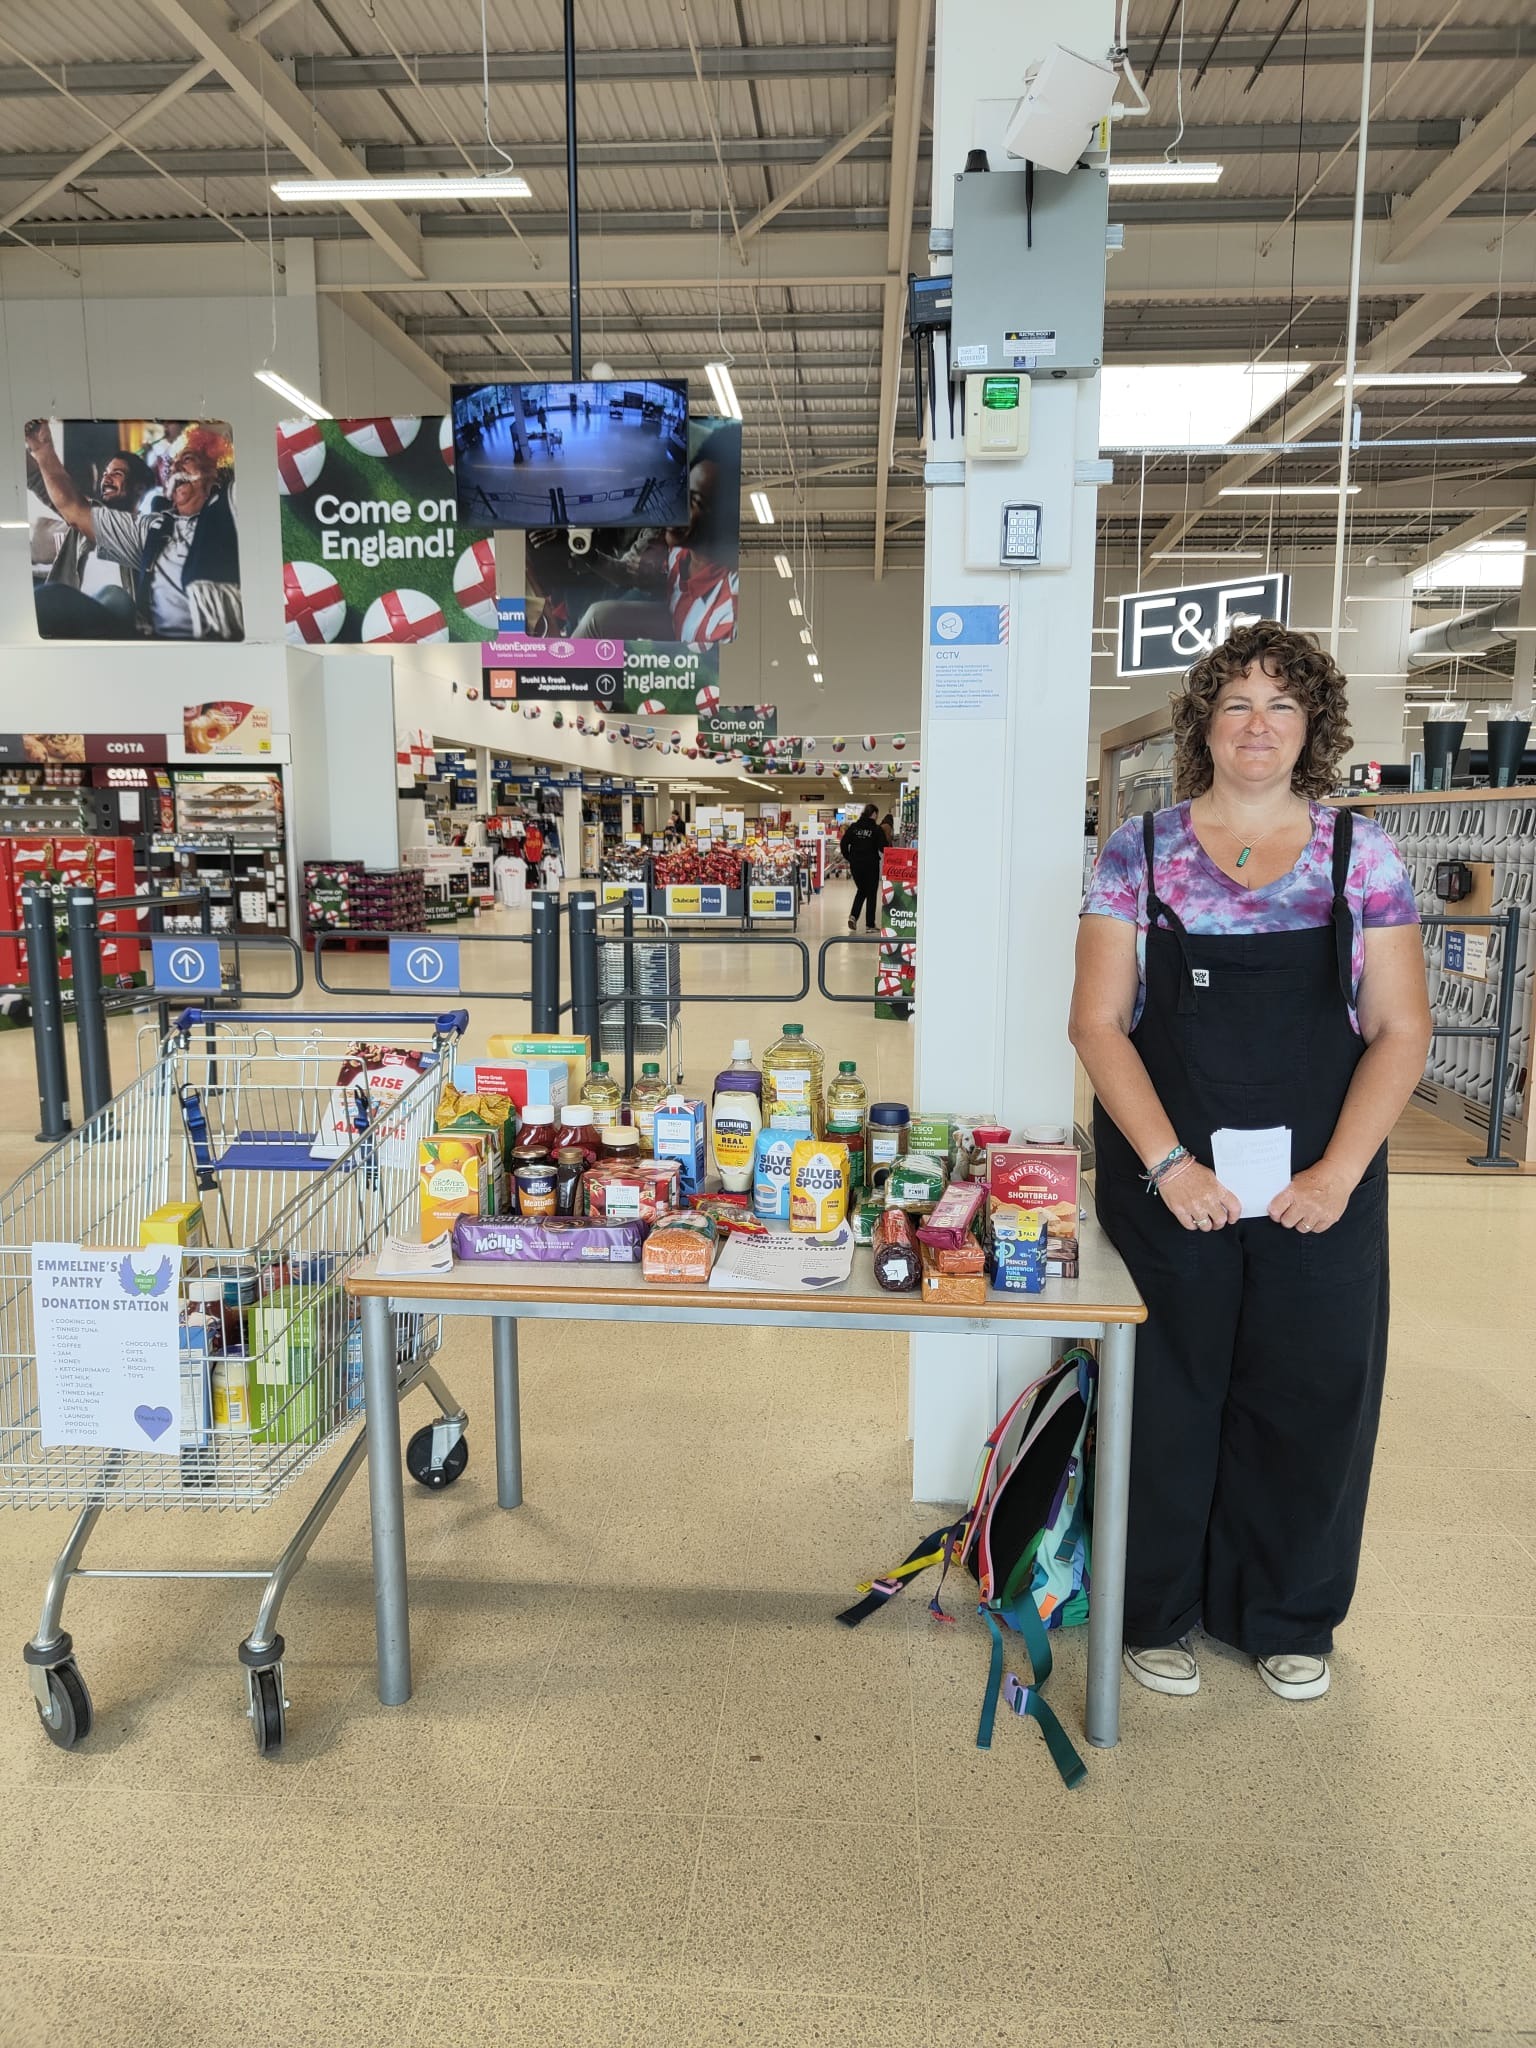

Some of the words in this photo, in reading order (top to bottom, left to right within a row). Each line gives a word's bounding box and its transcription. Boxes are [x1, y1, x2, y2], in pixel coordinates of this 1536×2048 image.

[315, 494, 411, 524] Come
[418, 499, 457, 522] on
[321, 528, 455, 567] England!
[1132, 585, 1265, 667] F&F
[674, 654, 699, 669] on
[936, 651, 960, 660] CCTV
[520, 676, 540, 684] Sushi
[540, 676, 546, 684] &
[547, 676, 566, 684] fresh
[571, 683, 588, 691] food
[710, 719, 746, 731] Come
[749, 720, 764, 730] on
[106, 742, 145, 754] COSTA
[106, 768, 148, 780] COSTA
[890, 908, 914, 918] Come
[422, 1056, 436, 1064] New
[370, 1076, 404, 1090] RISE
[717, 1121, 749, 1130] HELLMANN'S
[722, 1137, 744, 1145] REAL
[760, 1154, 792, 1164] SILVE
[759, 1164, 792, 1176] SPOO
[798, 1168, 842, 1180] SILVER
[1008, 1165, 1060, 1184] PATERSON'S
[796, 1178, 842, 1190] SPOON
[1008, 1192, 1058, 1200] SHORTBREAD
[524, 1198, 554, 1208] Meatballs
[475, 1234, 524, 1256] Molly's
[735, 1240, 795, 1250] DONATION
[37, 1260, 118, 1273] EMMELINE'S
[52, 1276, 103, 1288] PANTRY
[42, 1298, 110, 1310] DONATION
[112, 1300, 169, 1312] STATION
